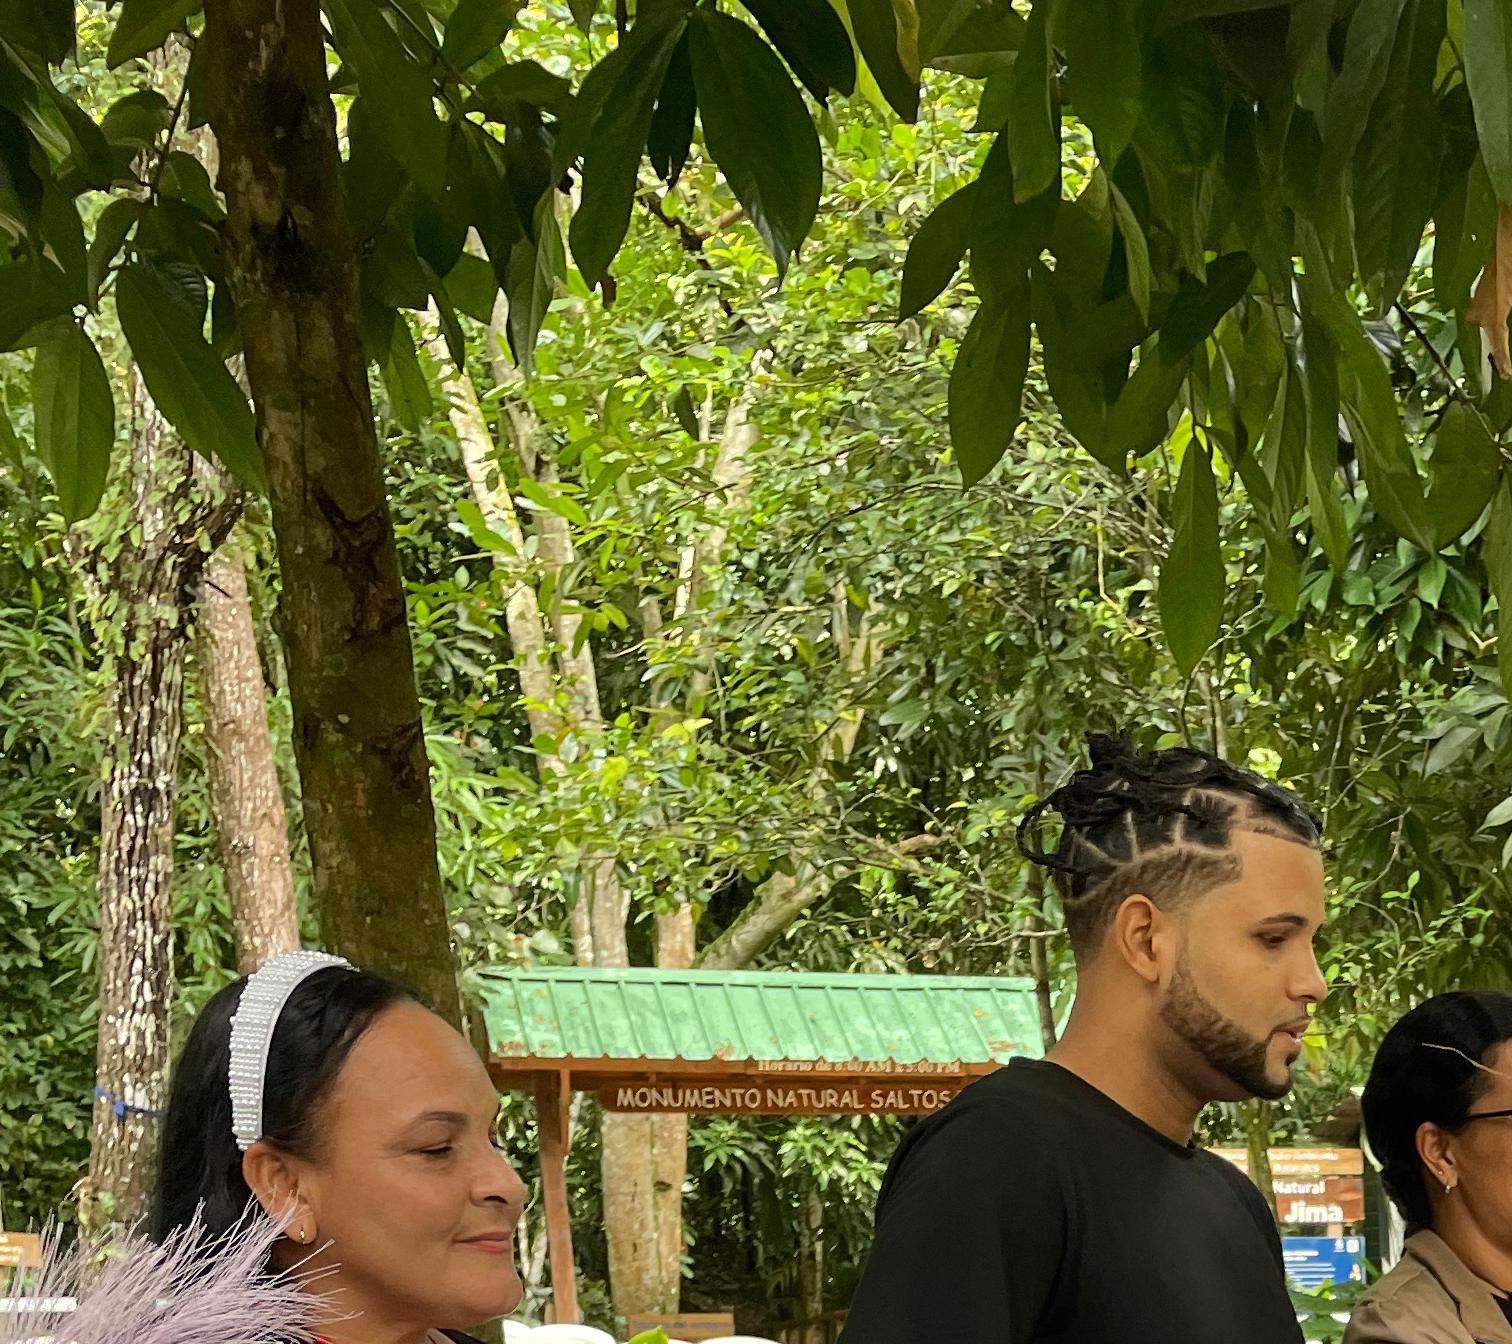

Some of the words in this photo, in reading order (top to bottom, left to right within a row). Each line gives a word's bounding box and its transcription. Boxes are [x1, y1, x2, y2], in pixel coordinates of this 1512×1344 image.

[616, 1086, 762, 1109] MONUMENTO
[766, 1088, 865, 1109] NATURAL
[870, 1089, 951, 1109] SALTOS
[1272, 1179, 1325, 1195] Natural
[1284, 1200, 1343, 1223] Jima
